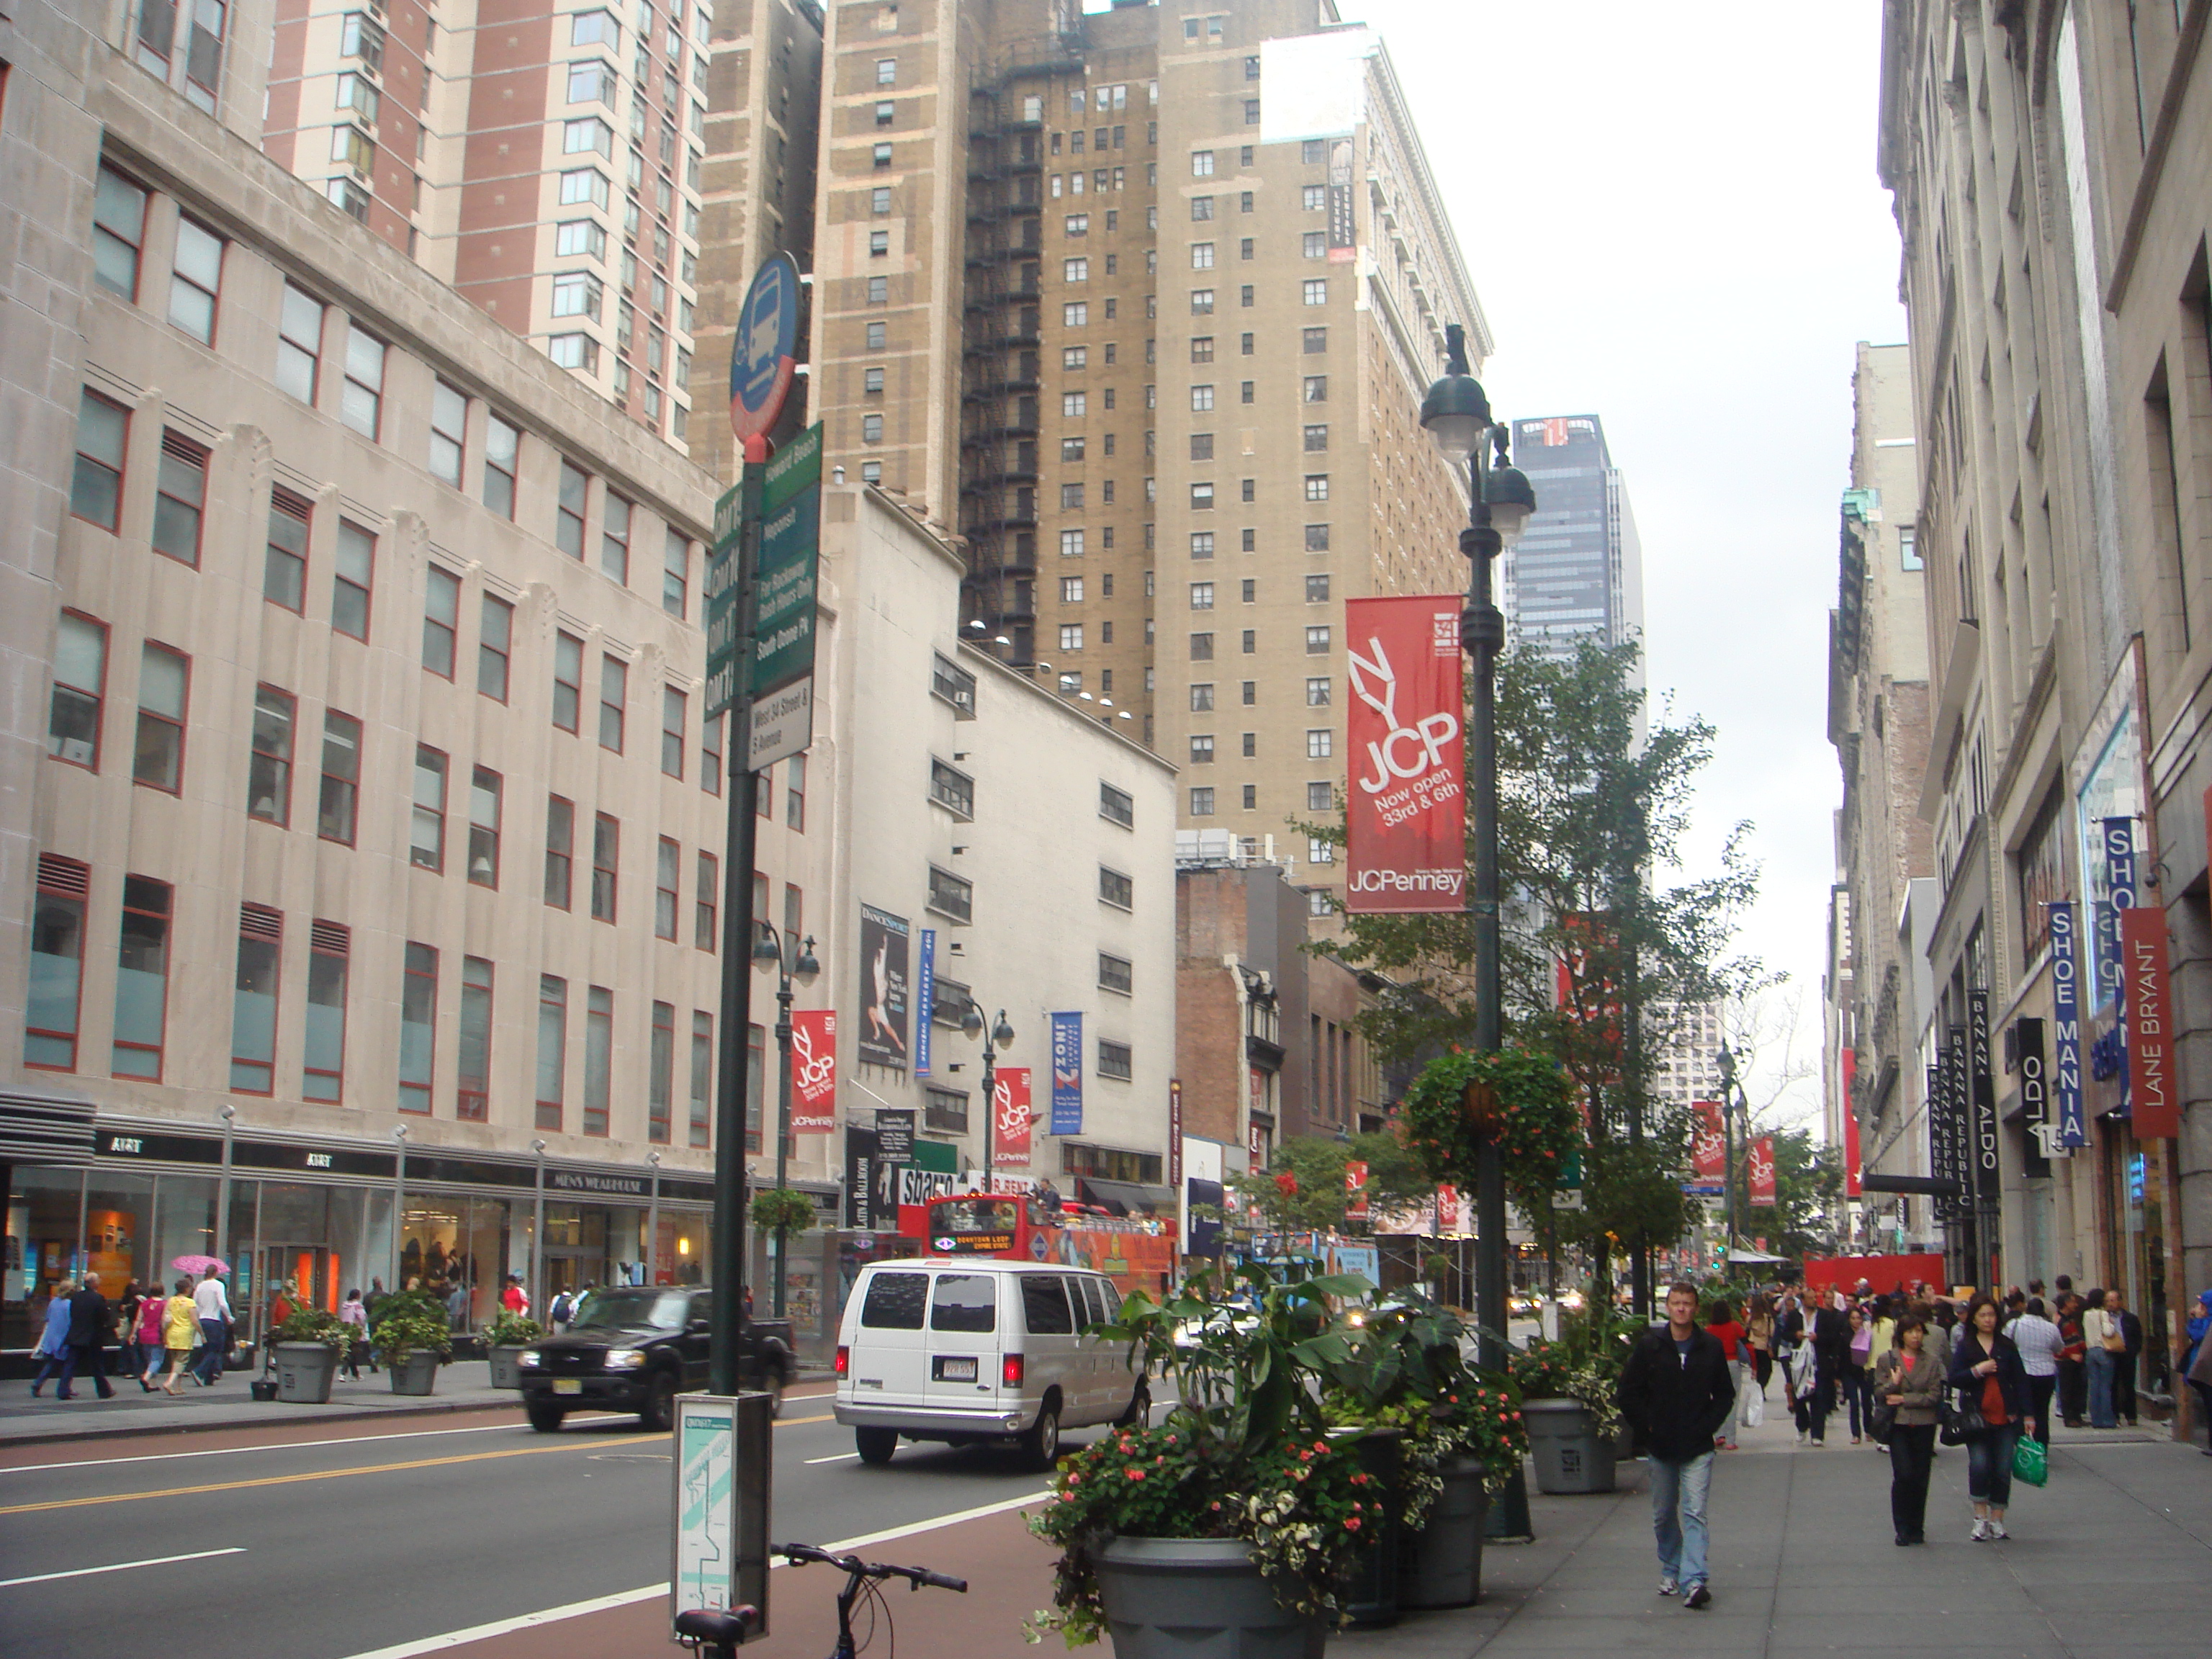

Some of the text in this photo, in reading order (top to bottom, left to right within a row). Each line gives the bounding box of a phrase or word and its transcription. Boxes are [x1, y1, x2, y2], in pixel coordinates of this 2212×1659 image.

[757, 634, 777, 661] South
[781, 695, 802, 717] Street
[759, 729, 782, 749] Avenue
[1359, 711, 1459, 794] JCP
[1374, 767, 1452, 814] Now open
[1381, 781, 1460, 828] 33rd & 6th
[1349, 868, 1464, 896] JCPenney
[2051, 912, 2082, 1137] SHOE MANIA
[2134, 940, 2164, 1107] LANE BRYANT
[1055, 1024, 1066, 1067] ZONI
[796, 1056, 835, 1089] JCP
[998, 1105, 1030, 1130] JCP
[1940, 1056, 1956, 1212] BANANA REPUBC
[1952, 1034, 1971, 1206] BANANA REPUBLIC
[1978, 1104, 1996, 1169] ALDO
[110, 1136, 143, 1154] AT&T
[1929, 1072, 1945, 1216] BANANA REPUIC
[853, 1157, 868, 1199] BALLROOM
[980, 1177, 1030, 1196] FR RENT
[853, 1206, 868, 1230] LATIN
